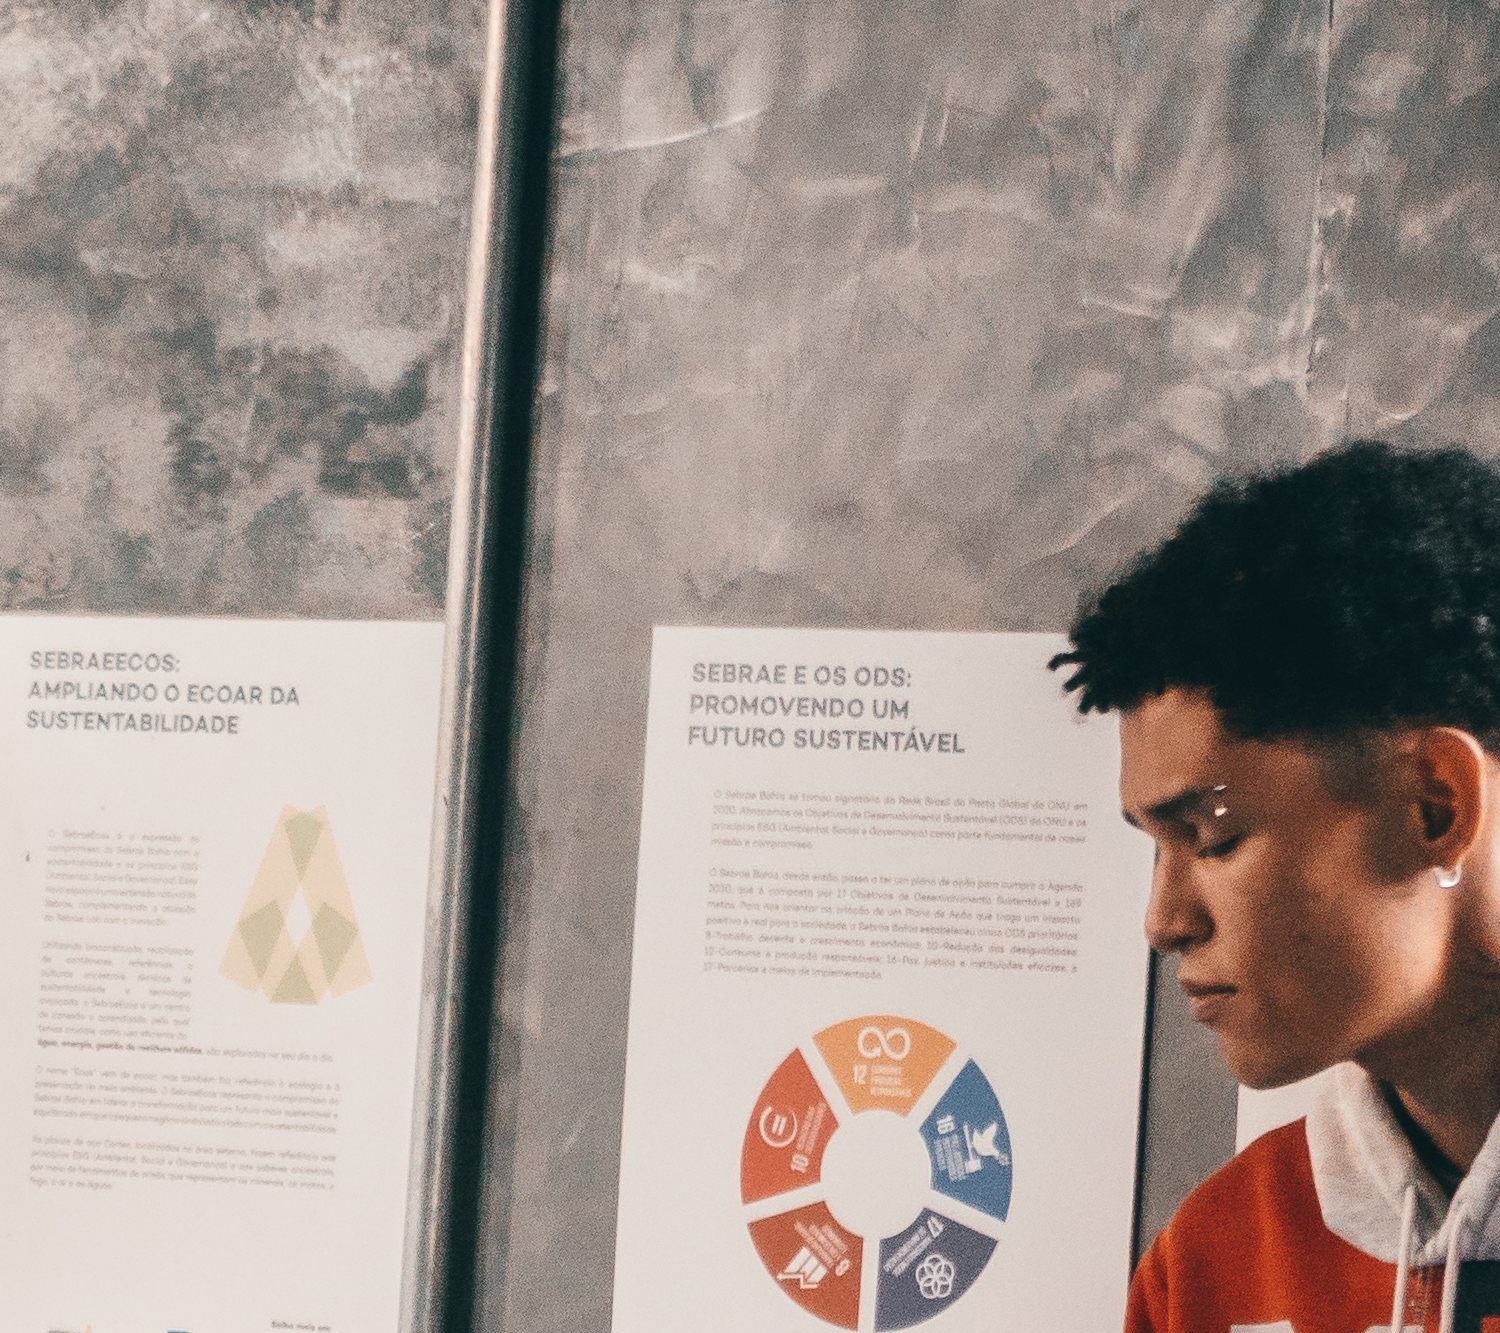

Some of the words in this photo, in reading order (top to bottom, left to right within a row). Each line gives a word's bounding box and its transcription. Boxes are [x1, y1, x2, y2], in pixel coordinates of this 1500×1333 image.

[30, 650, 181, 672] SEBRAEECOS:
[692, 662, 786, 684] SEBRAE
[793, 664, 806, 684] E
[813, 665, 847, 686] OS
[854, 665, 911, 687] ODS:
[28, 680, 158, 701] AMPLIANDO
[164, 683, 180, 702] O
[186, 683, 263, 704] ECOAR
[269, 685, 299, 705] DA
[689, 693, 864, 718] PROMOVENDO
[872, 698, 909, 719] UM
[26, 709, 238, 734] SUSTENTABILIDADE
[687, 725, 785, 747] FUTURO
[793, 723, 964, 753] SUSTENTÁVEL
[853, 1064, 867, 1085] 12
[791, 1153, 809, 1172] 10
